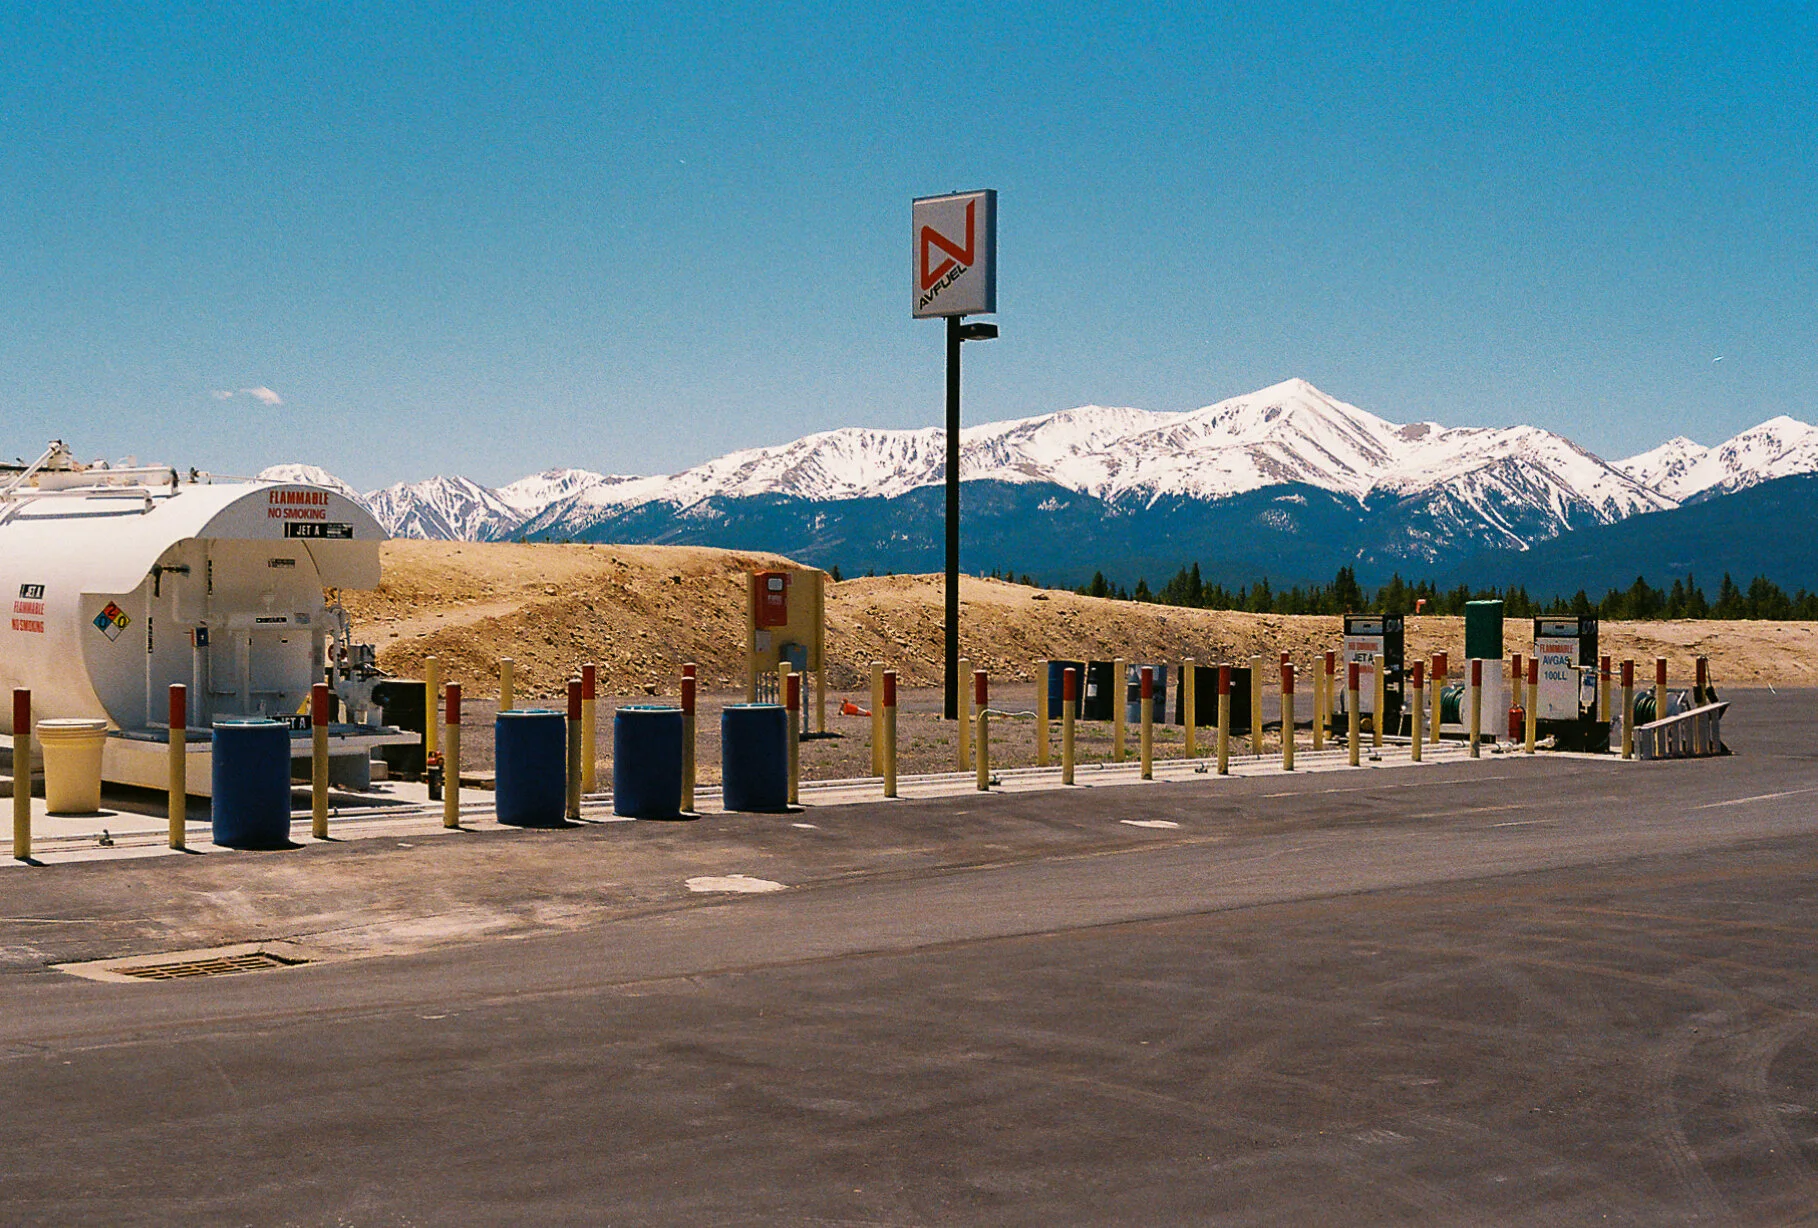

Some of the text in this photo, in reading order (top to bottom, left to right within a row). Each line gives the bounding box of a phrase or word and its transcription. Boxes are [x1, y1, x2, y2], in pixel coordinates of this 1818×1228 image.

[919, 265, 967, 310] AVFUEL
[269, 491, 329, 505] FLAMMABLE
[268, 508, 326, 519] NO SMOKING
[296, 525, 311, 535] JET
[314, 525, 320, 535] A
[14, 601, 45, 615] FLAMMABLE
[107, 604, 117, 617] 2
[99, 616, 126, 629] 0 0
[1540, 644, 1573, 653] FLAMMABLE
[1544, 671, 1567, 680] 100LL
[300, 717, 306, 729] A
